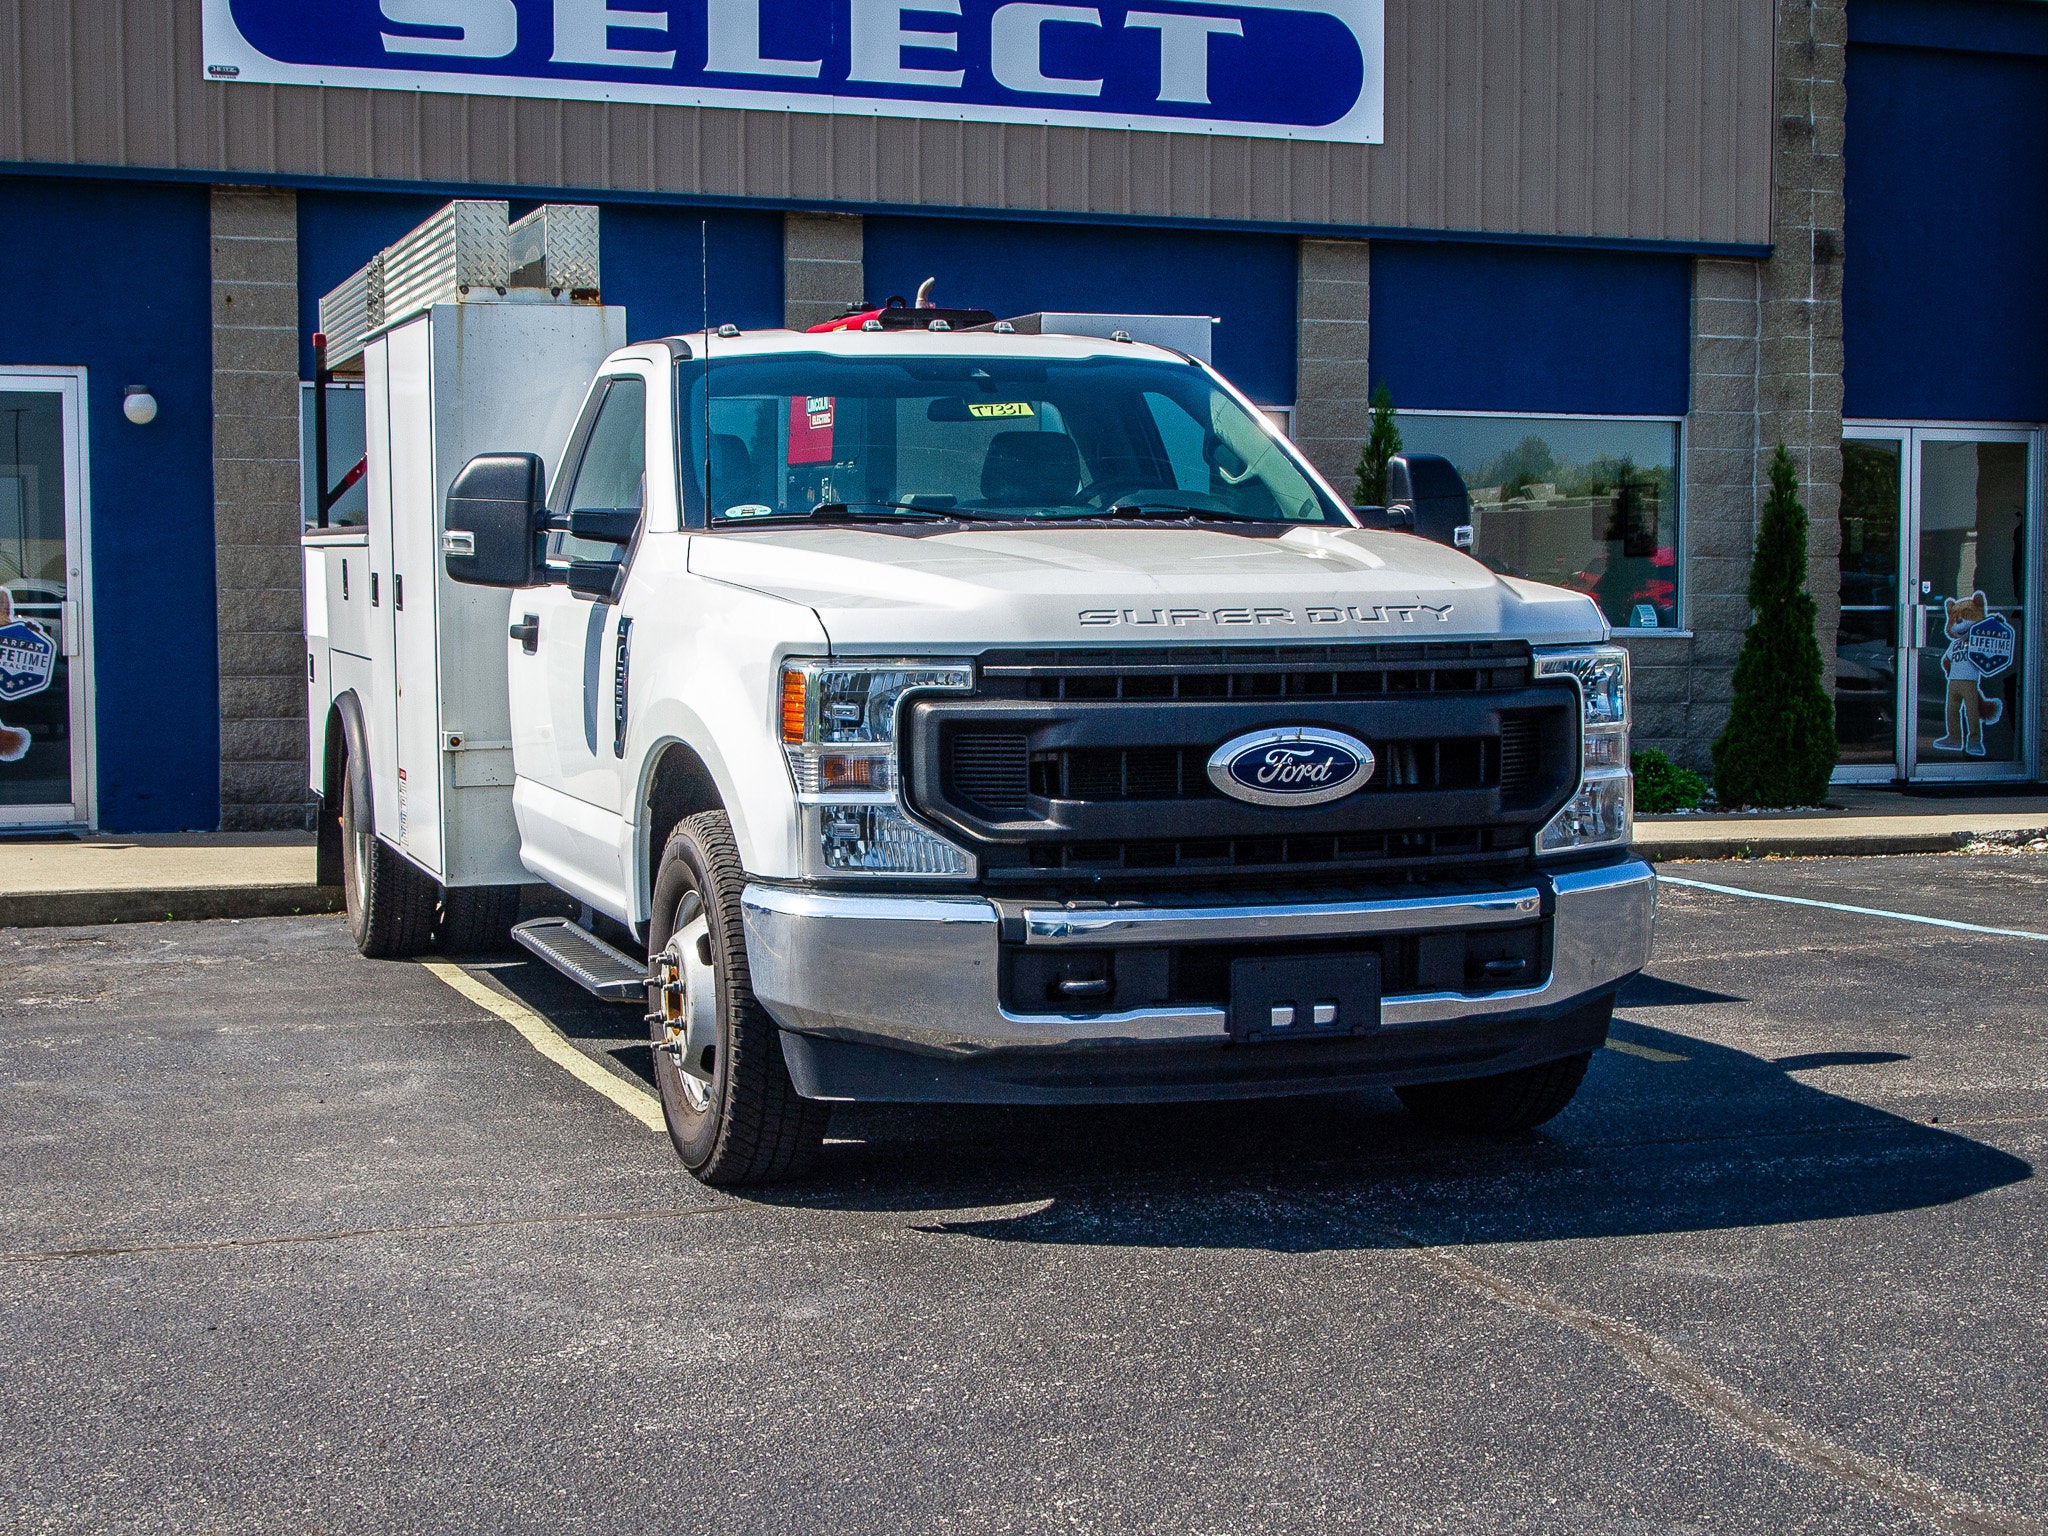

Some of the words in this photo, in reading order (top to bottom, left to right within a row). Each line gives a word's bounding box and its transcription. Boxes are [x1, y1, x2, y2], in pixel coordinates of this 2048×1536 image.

[379, 0, 1244, 104] SELECT
[1078, 608, 1296, 627] SUPER
[1307, 604, 1455, 625] DUTY
[0, 638, 45, 652] ARFAX
[1970, 636, 2010, 650] LIFETIME
[0, 648, 48, 668] FETIME
[0, 661, 34, 671] EALER
[1257, 748, 1334, 785] Ford
